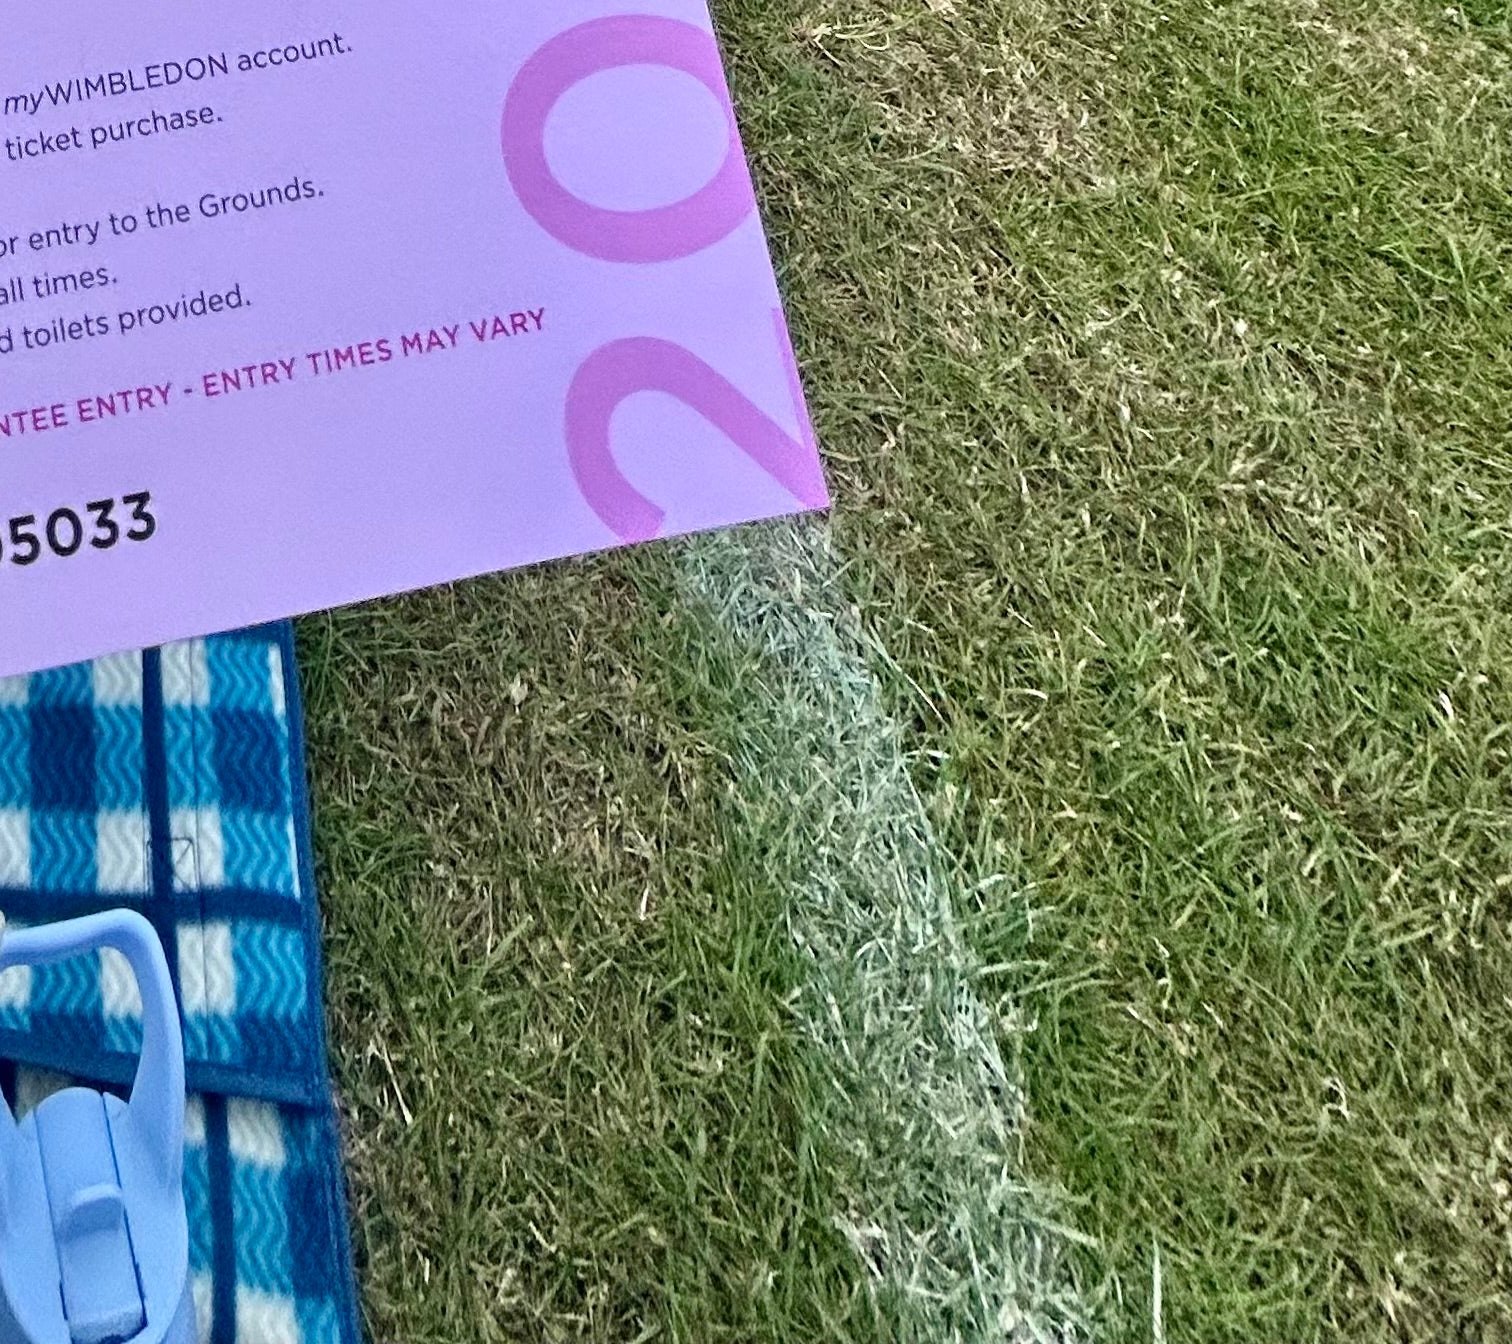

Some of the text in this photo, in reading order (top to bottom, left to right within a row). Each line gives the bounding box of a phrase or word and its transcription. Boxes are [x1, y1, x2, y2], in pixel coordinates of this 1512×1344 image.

[3, 50, 230, 117] myWIMBLEDON
[236, 31, 353, 73] account.
[3, 124, 84, 162] ticket
[89, 105, 224, 151] purchase.
[26, 219, 101, 253] entry
[107, 212, 139, 237] to
[144, 201, 191, 230] the
[197, 175, 325, 219] Grounds.
[20, 313, 111, 351] toilets
[116, 281, 253, 338] provided.
[31, 266, 119, 300] times.
[75, 381, 173, 424] ENTRY
[201, 356, 297, 398] ENTRY
[305, 337, 394, 376] TIMES
[399, 323, 461, 358] MAY
[468, 306, 546, 343] VARY
